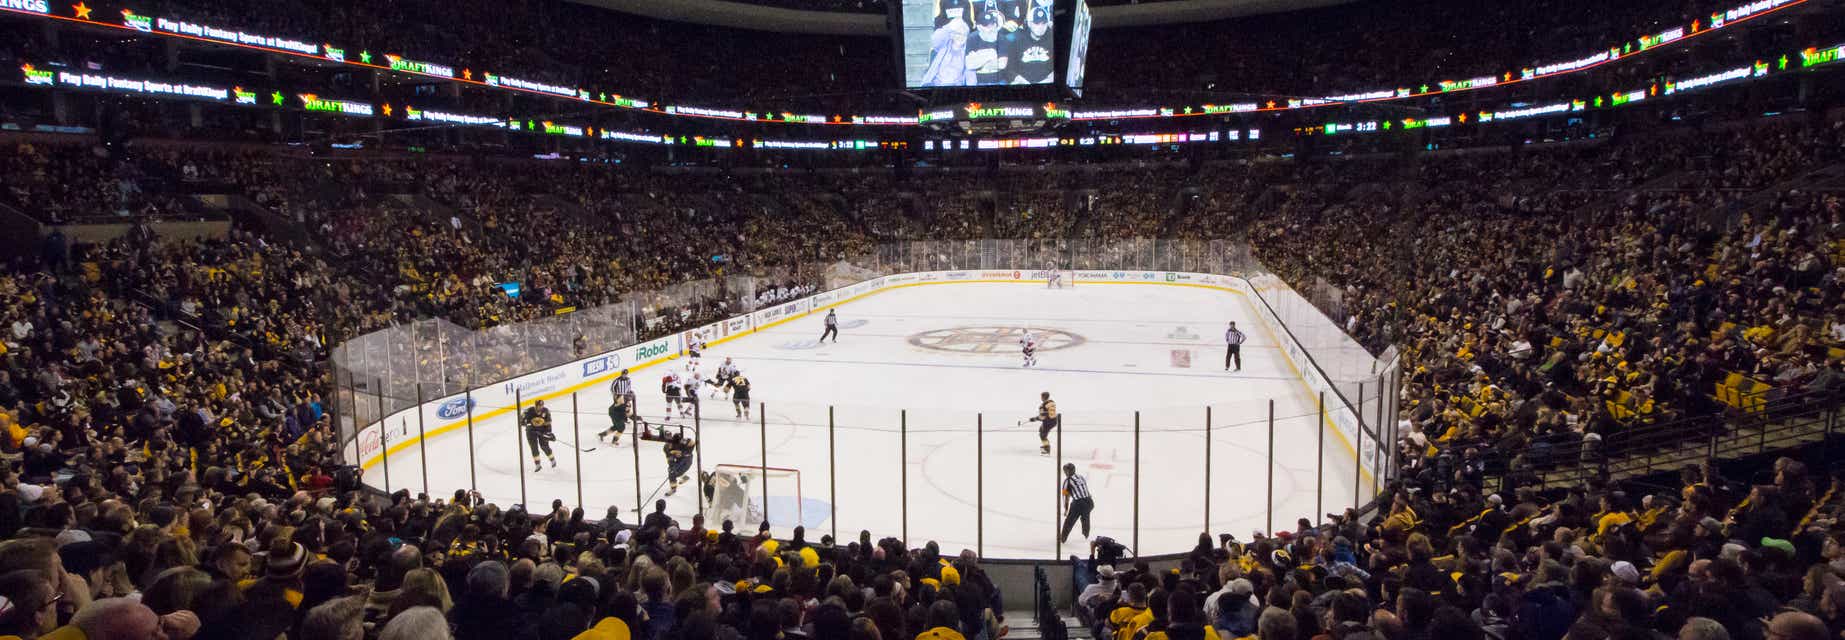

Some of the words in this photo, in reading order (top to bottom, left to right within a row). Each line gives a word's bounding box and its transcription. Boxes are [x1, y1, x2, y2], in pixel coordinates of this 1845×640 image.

[158, 18, 179, 33] Play
[180, 21, 203, 37] Daily
[391, 60, 453, 78] DRAFTKINGS
[60, 71, 82, 86] Play
[82, 73, 106, 89] Daily
[305, 99, 373, 116] DRAFTKINGS
[969, 107, 1033, 119] DRAFTKINGS
[1357, 121, 1377, 132] 3:22
[635, 341, 669, 361] iRobot
[445, 402, 468, 417] Ford
